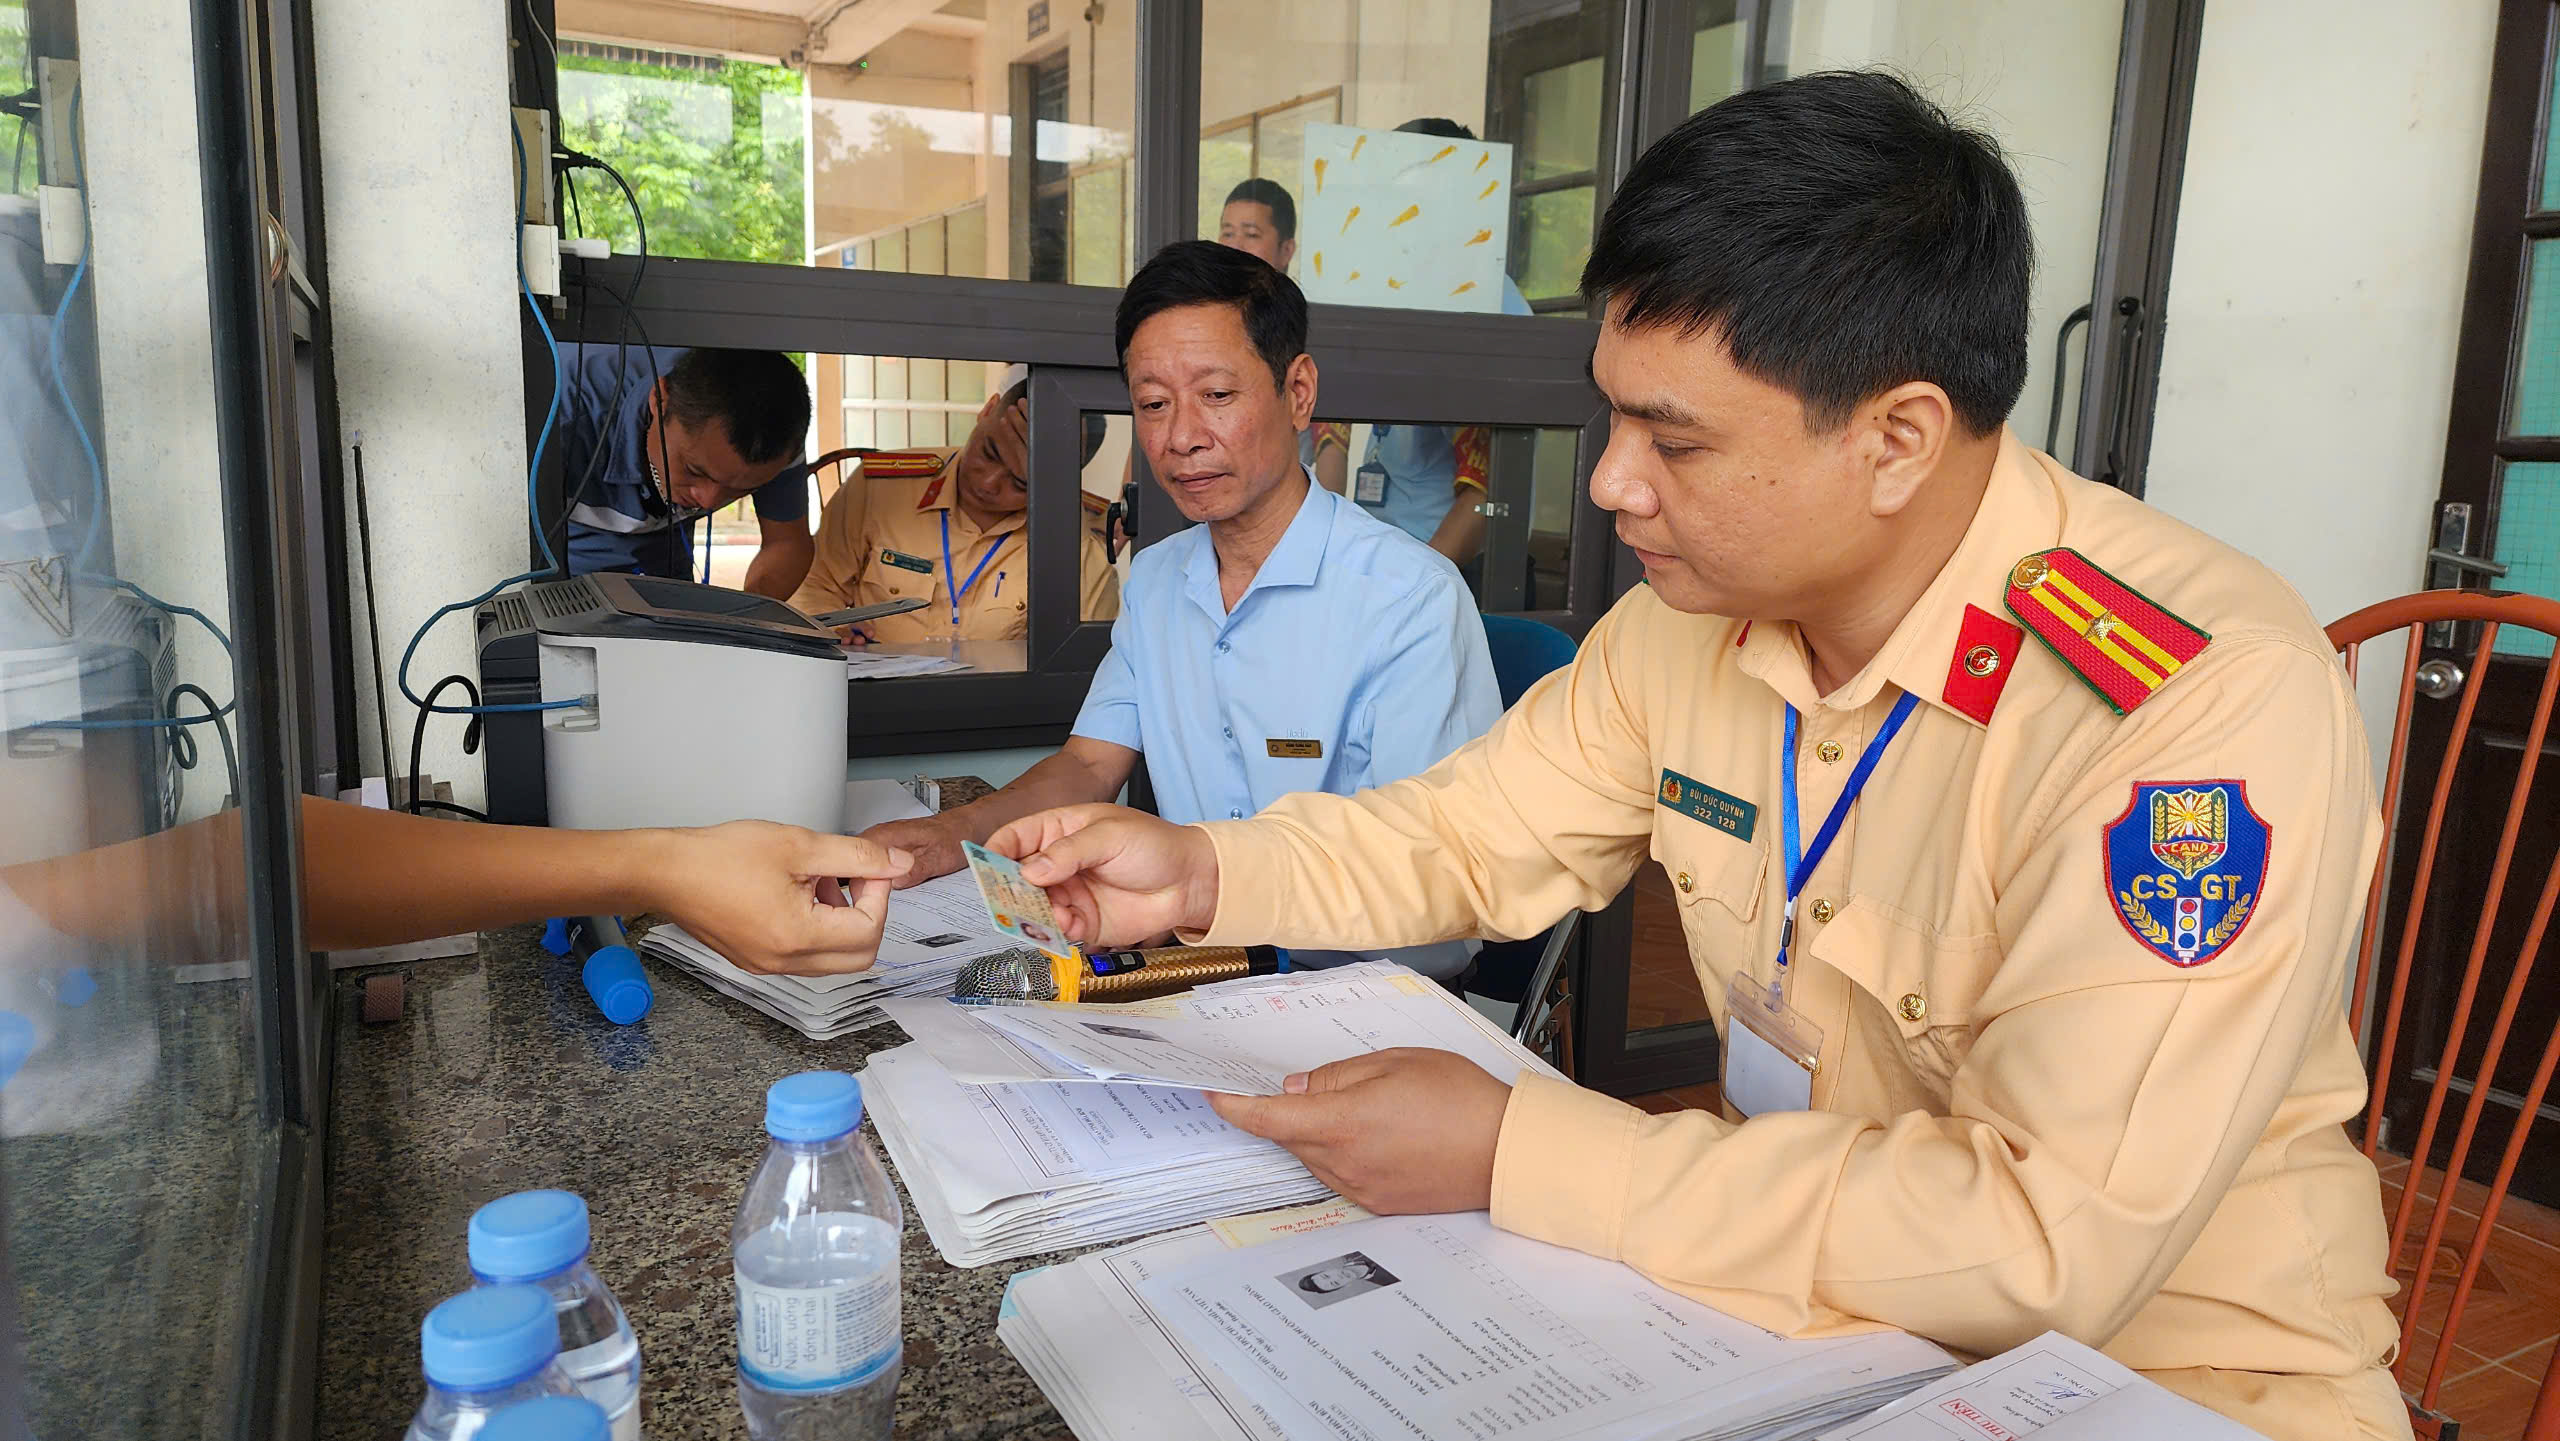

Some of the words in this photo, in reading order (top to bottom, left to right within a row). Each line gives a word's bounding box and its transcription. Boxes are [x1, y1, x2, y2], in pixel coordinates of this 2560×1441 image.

[1689, 788, 1702, 801] BÙI
[1693, 805, 1712, 820] 322
[1718, 815, 1736, 830] 128
[2171, 843, 2209, 853] CAND
[2131, 874, 2177, 899] CS
[2200, 874, 2242, 900] GT
[1950, 1400, 1981, 1421] TIỀN
[1977, 1420, 2005, 1437] THU
